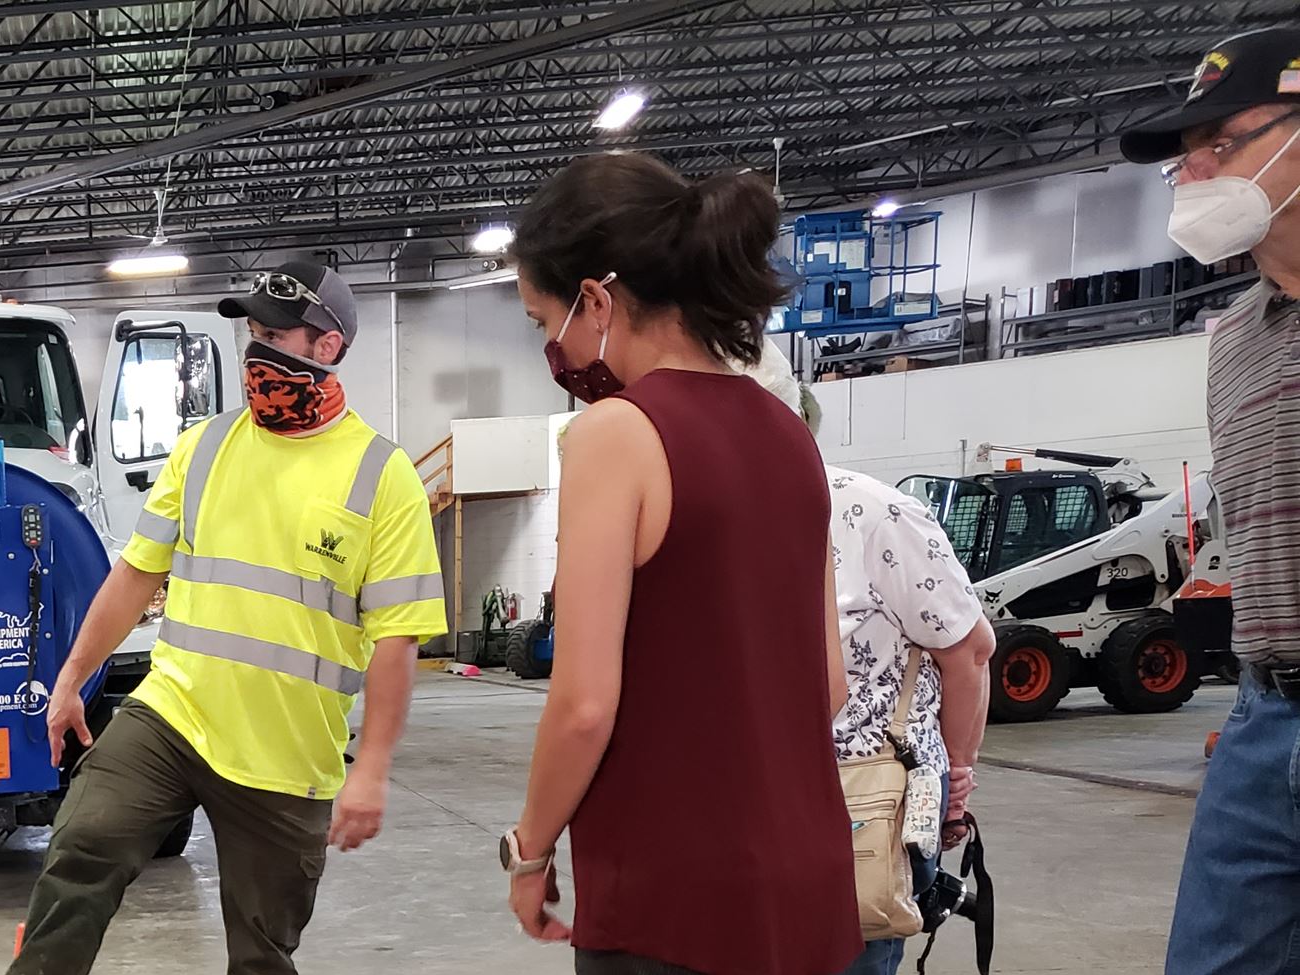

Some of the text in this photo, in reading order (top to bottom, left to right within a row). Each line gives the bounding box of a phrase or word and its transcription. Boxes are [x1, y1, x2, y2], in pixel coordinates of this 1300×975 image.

[305, 542, 347, 564] WARRENVILLE
[1107, 567, 1128, 577] 320
[14, 693, 39, 704] ECO
